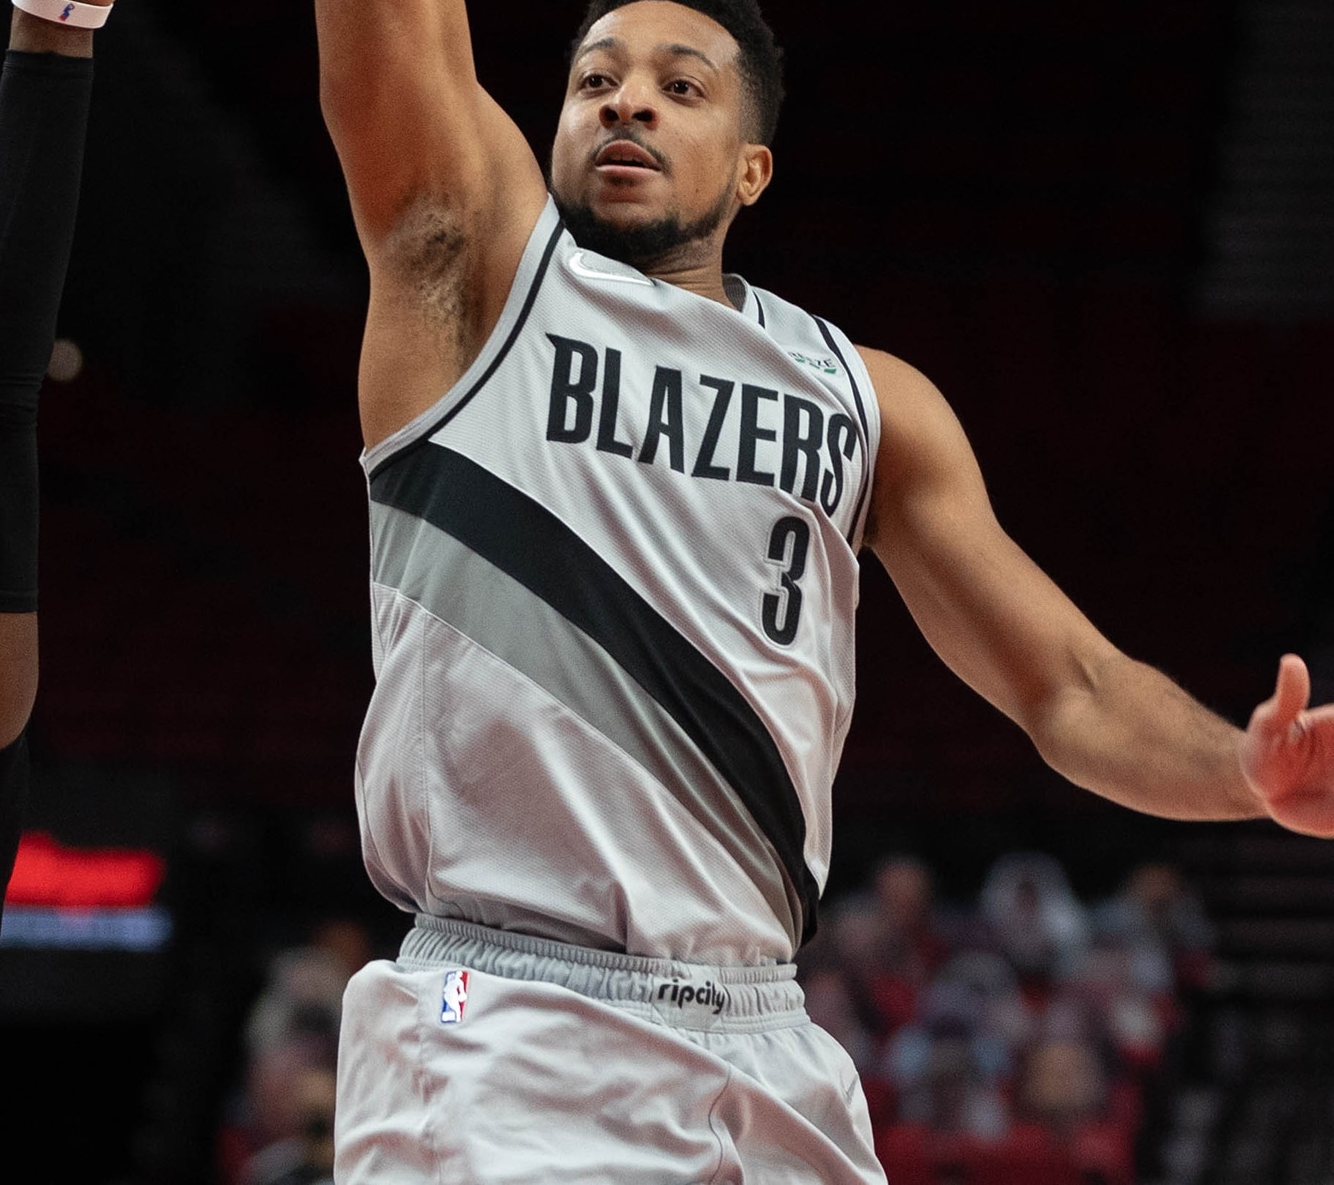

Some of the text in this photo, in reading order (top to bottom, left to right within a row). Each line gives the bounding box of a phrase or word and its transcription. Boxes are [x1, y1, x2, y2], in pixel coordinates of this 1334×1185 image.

[546, 333, 857, 517] BLAZERS
[762, 515, 810, 646] 3
[658, 978, 725, 1014] ripcity
